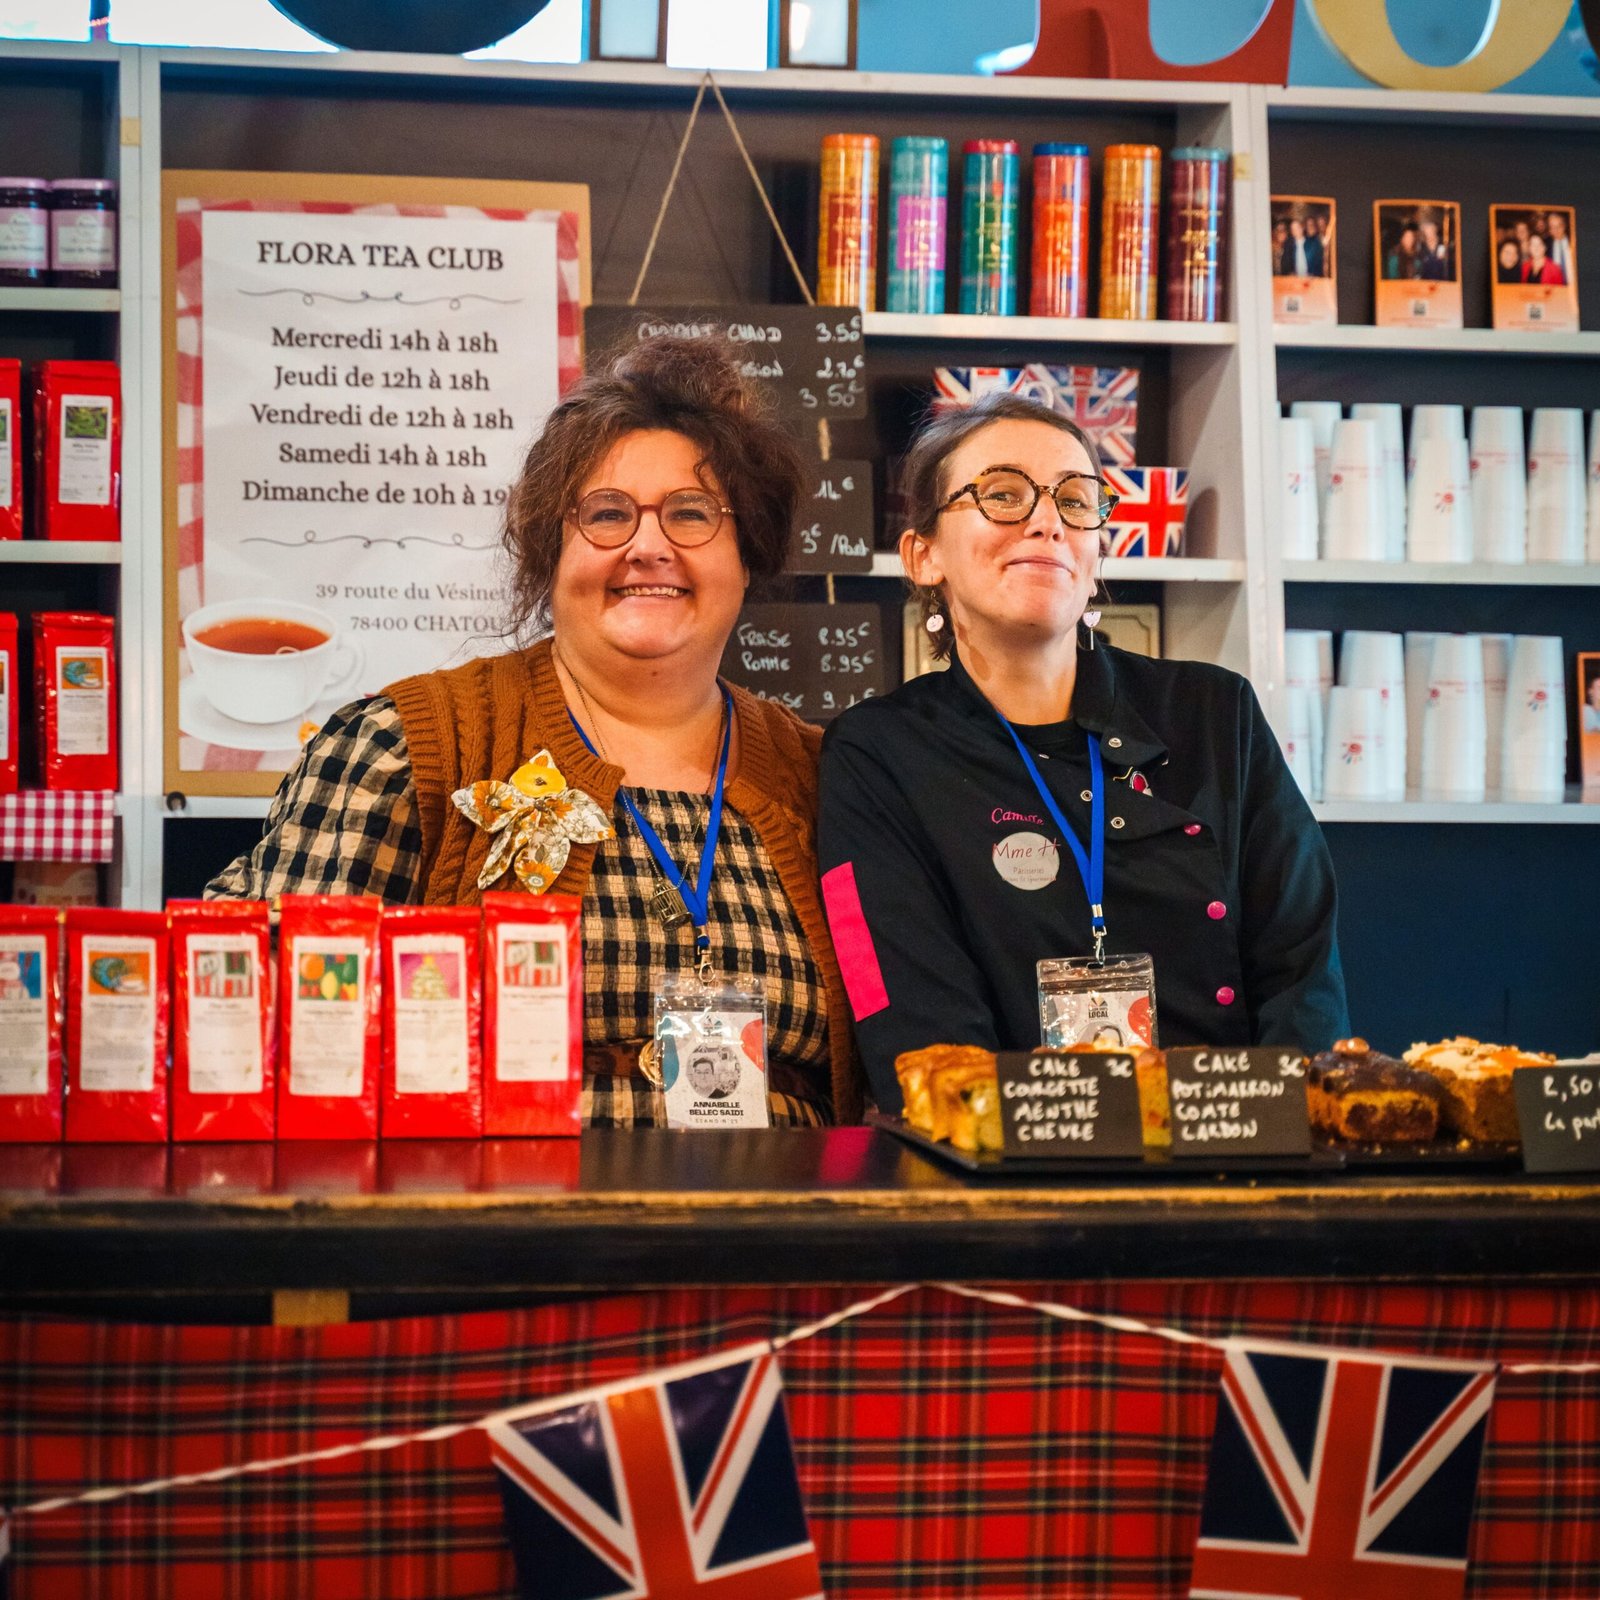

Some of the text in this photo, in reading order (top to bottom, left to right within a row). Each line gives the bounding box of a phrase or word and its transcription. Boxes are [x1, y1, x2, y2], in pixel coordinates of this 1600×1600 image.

[257, 241, 504, 271] FLORA TEA CLUB
[271, 327, 498, 354] Mercredi 14h à 18h
[274, 365, 491, 391] Jeudi de 12h à 18h
[251, 403, 514, 430] Vendredi de 12h à 18h
[279, 442, 487, 467] Samedi 14h à 18h
[242, 480, 369, 503] Dimanche
[376, 482, 406, 504] de
[413, 483, 455, 505] 10h
[463, 484, 475, 505] à
[316, 584, 338, 599] 39
[344, 585, 399, 599] route
[404, 582, 430, 600] du
[352, 616, 408, 631] 78400
[992, 841, 1033, 859] Mme
[1028, 1057, 1081, 1078] CAKE
[1193, 1051, 1250, 1073] CAKE
[693, 1101, 741, 1109] ANNABELLE
[1013, 1099, 1099, 1122] MENTHE
